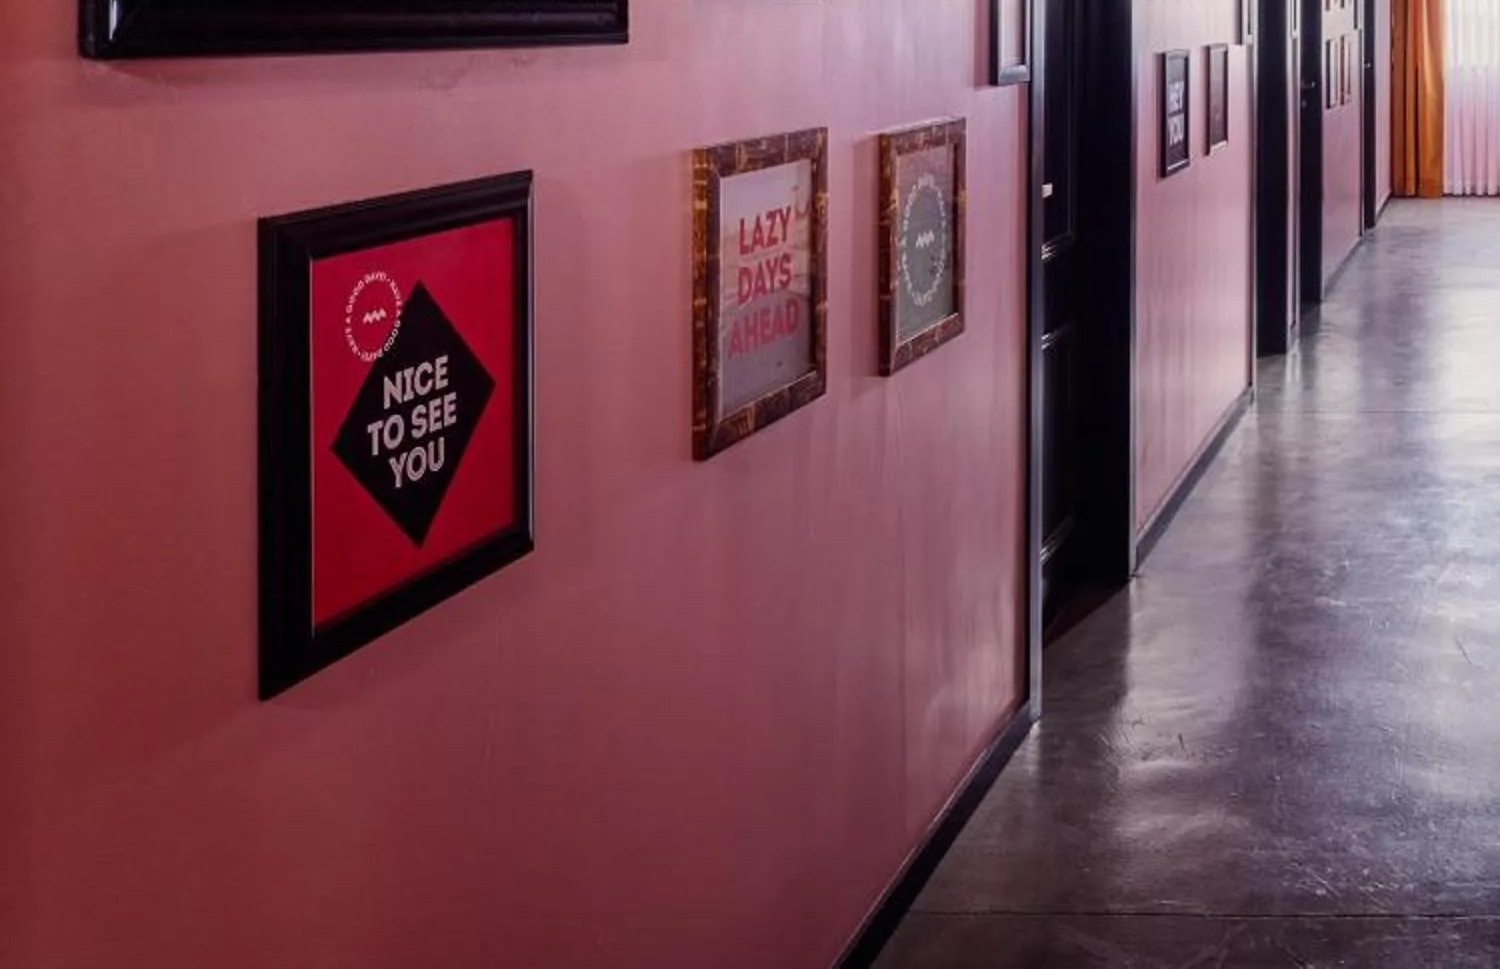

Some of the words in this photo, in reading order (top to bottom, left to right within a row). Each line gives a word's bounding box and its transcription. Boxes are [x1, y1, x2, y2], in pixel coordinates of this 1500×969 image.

[739, 204, 792, 256] LAZY
[736, 252, 792, 306] DAYS
[728, 298, 799, 357] AHEAD
[383, 354, 450, 409] NICE
[367, 413, 405, 456] TO
[410, 392, 458, 437] SEE
[389, 436, 446, 489] YOU
